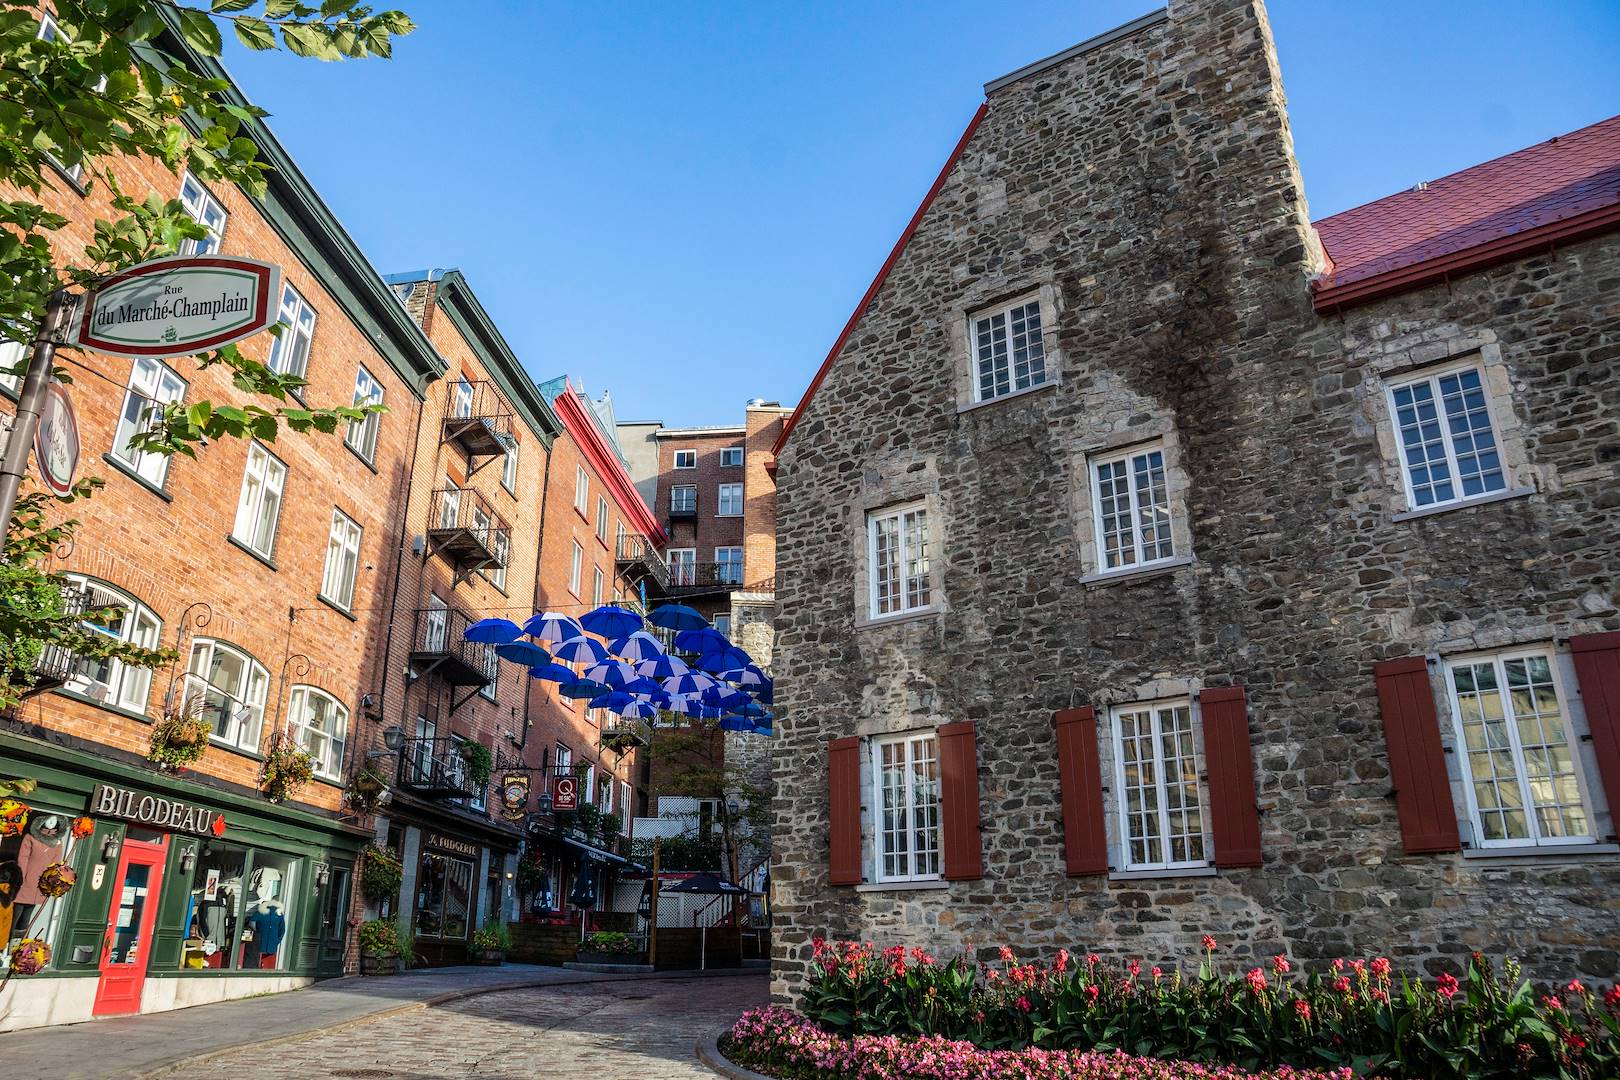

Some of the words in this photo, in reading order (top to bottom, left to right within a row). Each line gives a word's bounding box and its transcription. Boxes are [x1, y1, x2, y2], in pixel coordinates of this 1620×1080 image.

[164, 285, 183, 295] Rue
[97, 305, 114, 326] du
[117, 292, 249, 325] Marché-Champlain
[96, 784, 213, 833] BILODEAU
